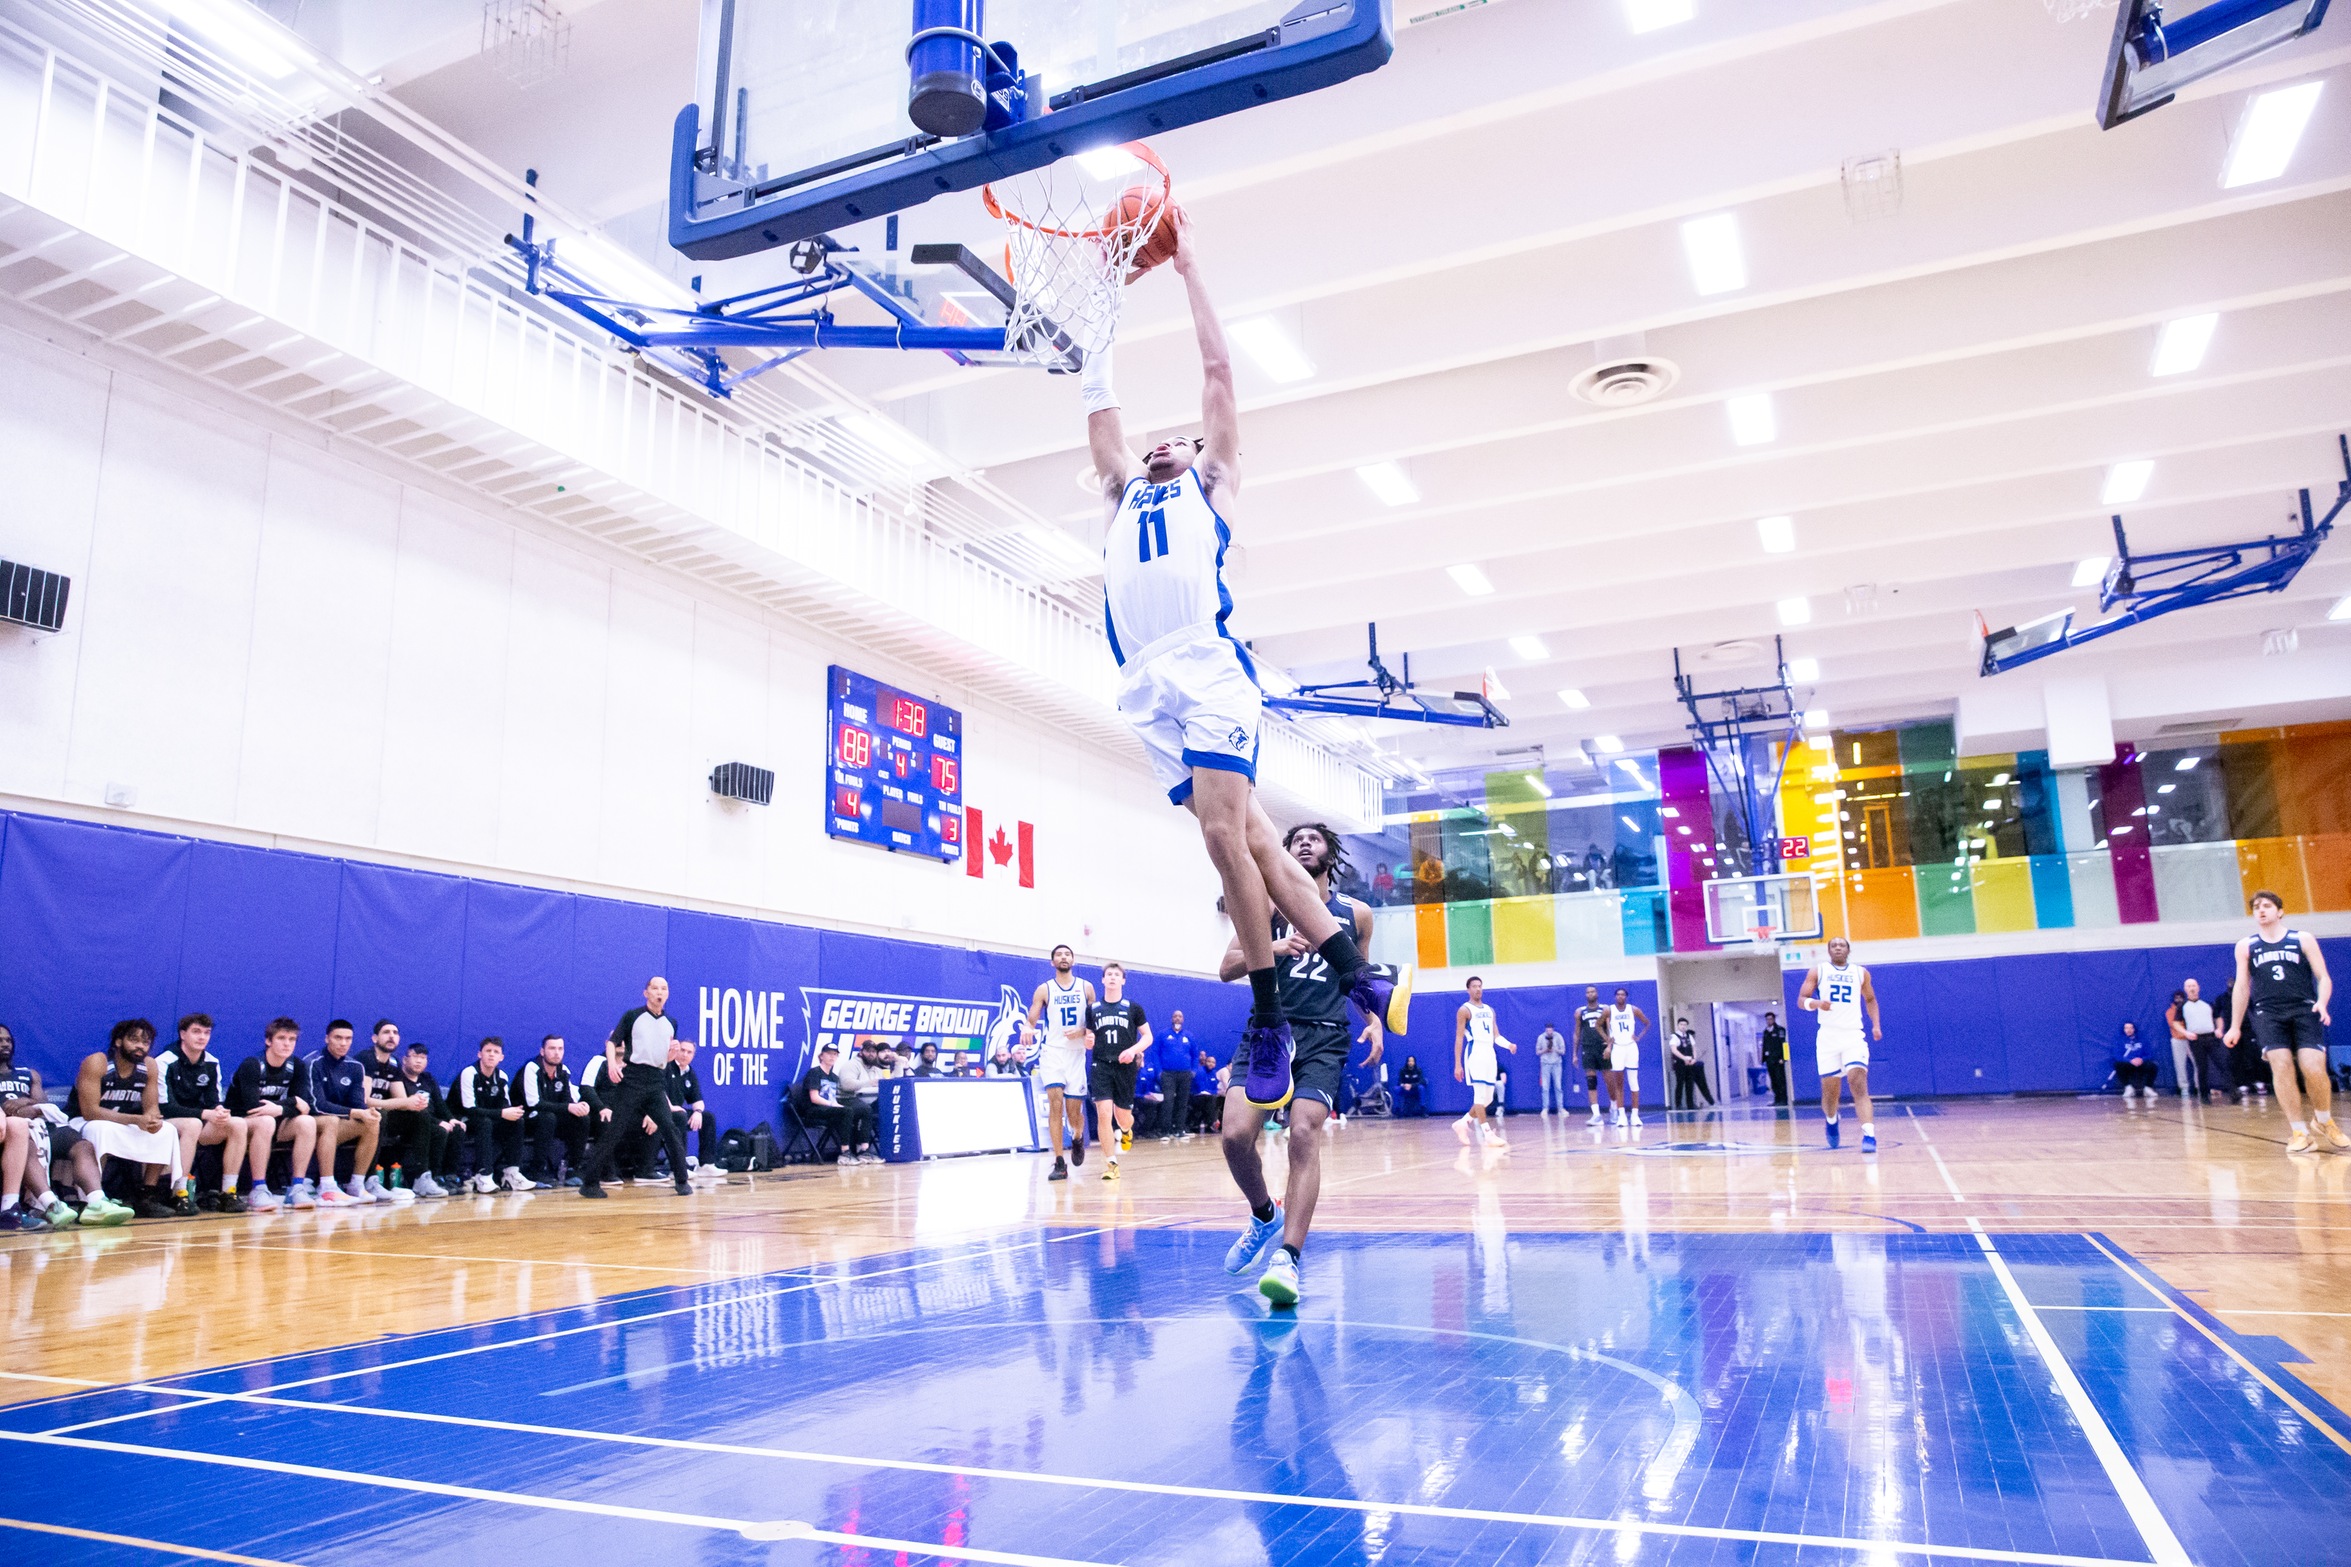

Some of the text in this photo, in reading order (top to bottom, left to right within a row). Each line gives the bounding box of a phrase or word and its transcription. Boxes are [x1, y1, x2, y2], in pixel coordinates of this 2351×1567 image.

[1137, 508, 1169, 563] 11
[843, 702, 868, 724] HOME
[896, 699, 925, 737] 1:38
[843, 728, 869, 766] 88
[933, 733, 956, 753] GUEST
[896, 753, 906, 776] 4
[936, 757, 956, 792] 75
[847, 792, 857, 816] 4
[949, 818, 958, 841] 3
[1782, 839, 1806, 857] 22
[1289, 952, 1329, 982] 22
[2271, 965, 2285, 981] 3
[1054, 994, 1081, 1005] HUSKIES
[1830, 984, 1852, 1003] 22
[699, 986, 785, 1049] HOME
[821, 998, 989, 1035] GEORGE BROWN
[1060, 1007, 1077, 1026] 15
[1095, 1015, 1129, 1030] LAMBTON
[1483, 1020, 1490, 1034] 4
[1618, 1021, 1629, 1032] 14
[1105, 1029, 1118, 1044] 11
[713, 1052, 768, 1086] OF THE
[892, 1085, 901, 1153] HUSKIES
